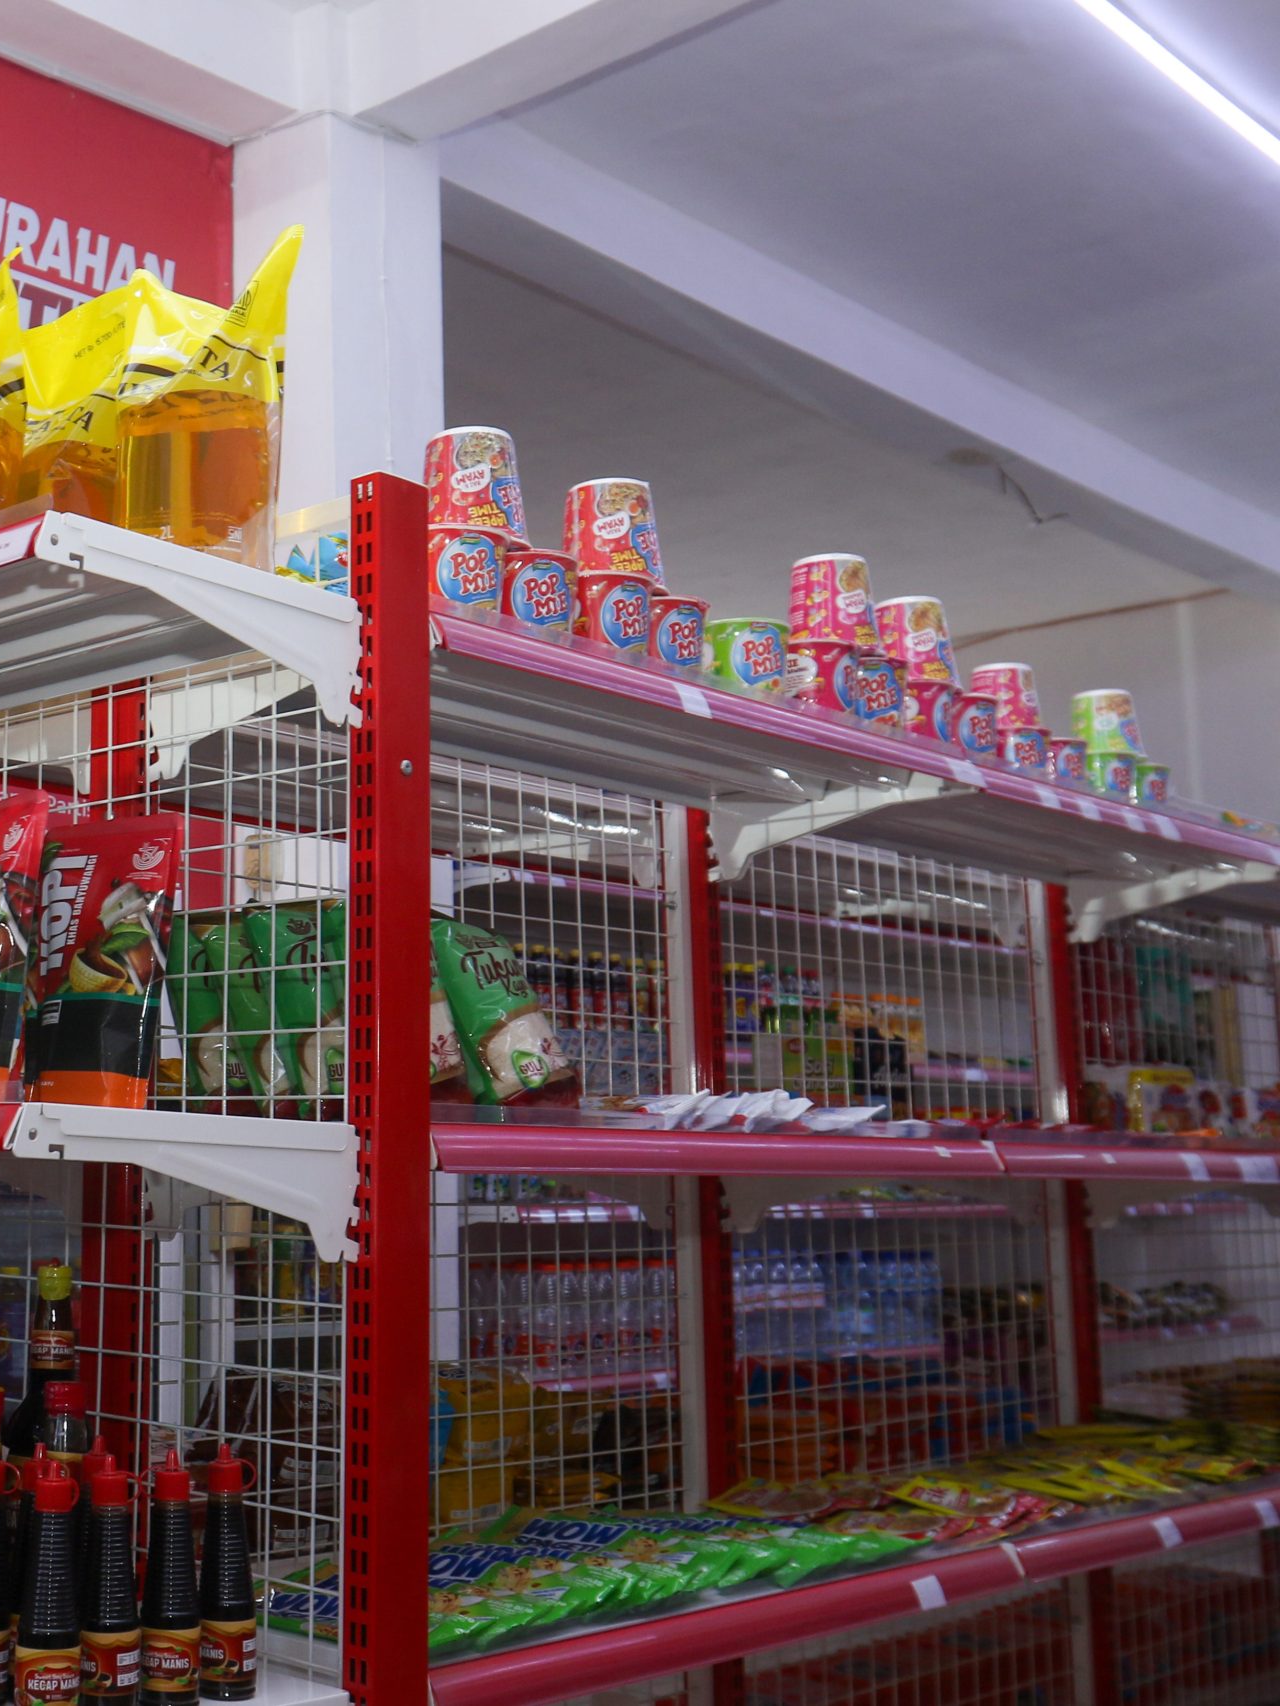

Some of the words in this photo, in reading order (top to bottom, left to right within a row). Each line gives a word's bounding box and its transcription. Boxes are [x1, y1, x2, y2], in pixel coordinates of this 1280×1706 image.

[449, 548, 490, 579] POP
[459, 565, 498, 595] MIE
[523, 572, 560, 605] POP
[532, 590, 570, 618] MIE
[612, 594, 644, 623] POP
[668, 618, 699, 644] POP
[742, 635, 775, 662] POP
[751, 652, 782, 676] MIE
[856, 672, 890, 698] POP
[865, 688, 898, 712] MIE
[72, 854, 99, 914] BANYUWANGI
[39, 854, 89, 978] KOPI
[66, 913, 80, 946] KHAS
[522, 1518, 629, 1545] WOW
[428, 1551, 497, 1578] OW
[27, 1678, 59, 1691] KECAP
